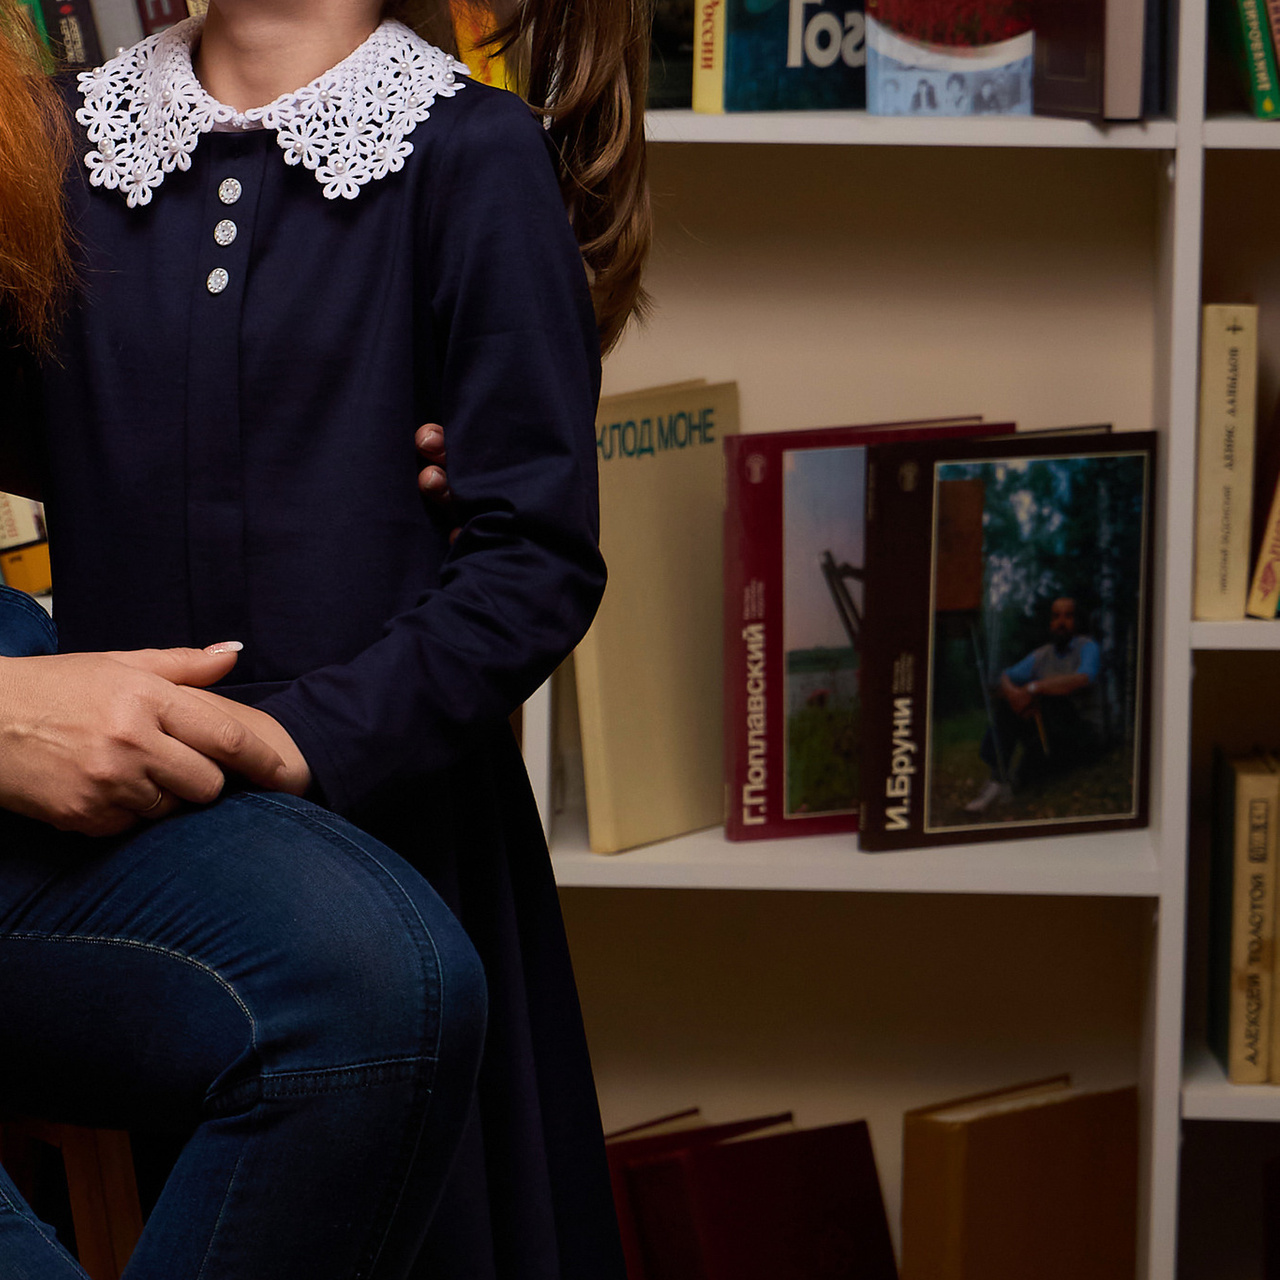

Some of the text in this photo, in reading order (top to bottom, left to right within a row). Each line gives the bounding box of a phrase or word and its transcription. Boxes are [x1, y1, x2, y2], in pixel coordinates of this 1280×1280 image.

[656, 407, 716, 452] МОНЕ
[1224, 346, 1239, 418] ДАВЫДОВ
[1224, 424, 1238, 471] ДЕНИС
[741, 623, 768, 827] Г.Поплавский
[883, 697, 918, 832] И.Бруни
[1242, 874, 1267, 1066] АЛЕКСЕЙ ТОЛСТОЙ
